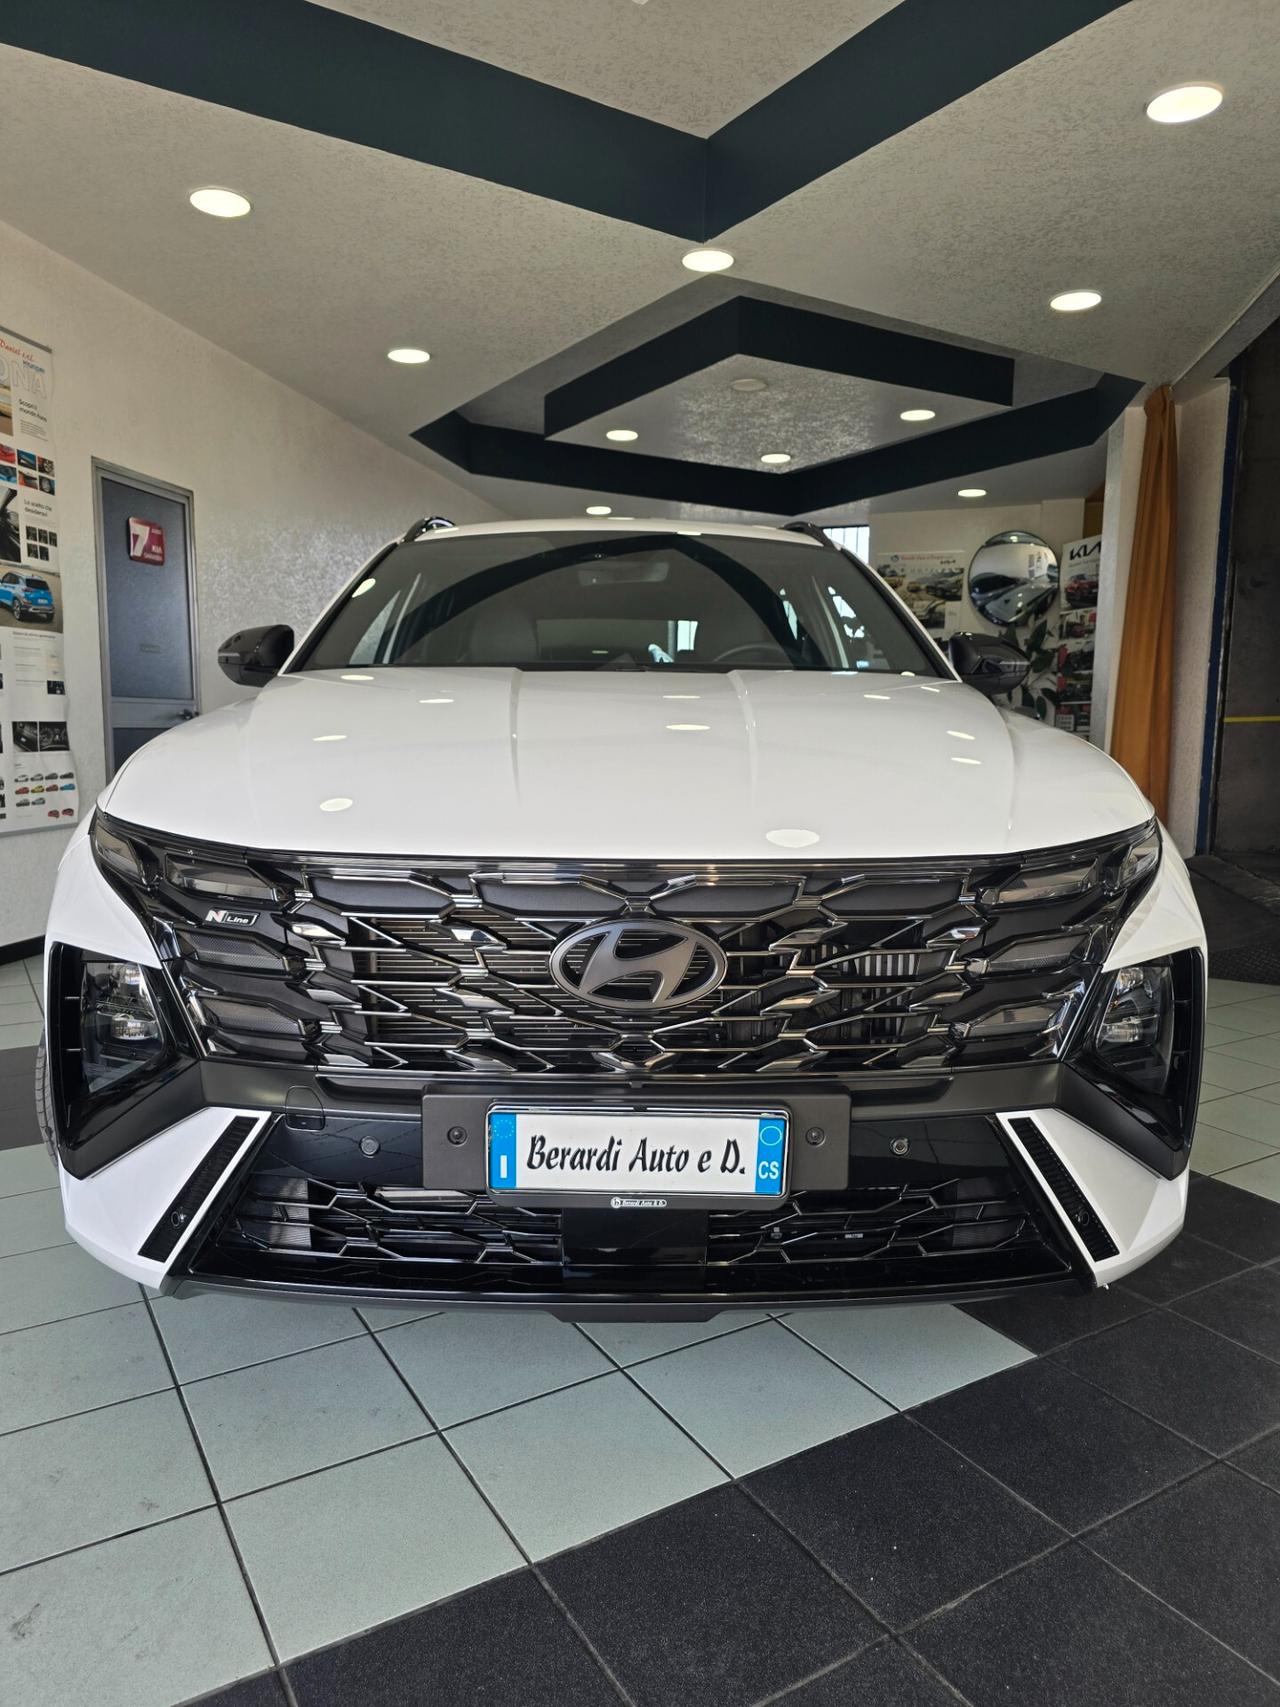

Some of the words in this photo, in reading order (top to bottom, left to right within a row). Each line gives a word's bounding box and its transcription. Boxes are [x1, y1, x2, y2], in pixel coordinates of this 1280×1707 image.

[205, 910, 227, 923] N
[226, 916, 249, 924] Line
[526, 1135, 623, 1172] Berardi
[628, 1137, 690, 1172] Auto
[697, 1148, 712, 1173] e
[720, 1138, 746, 1175] D.
[758, 1160, 780, 1180] CS
